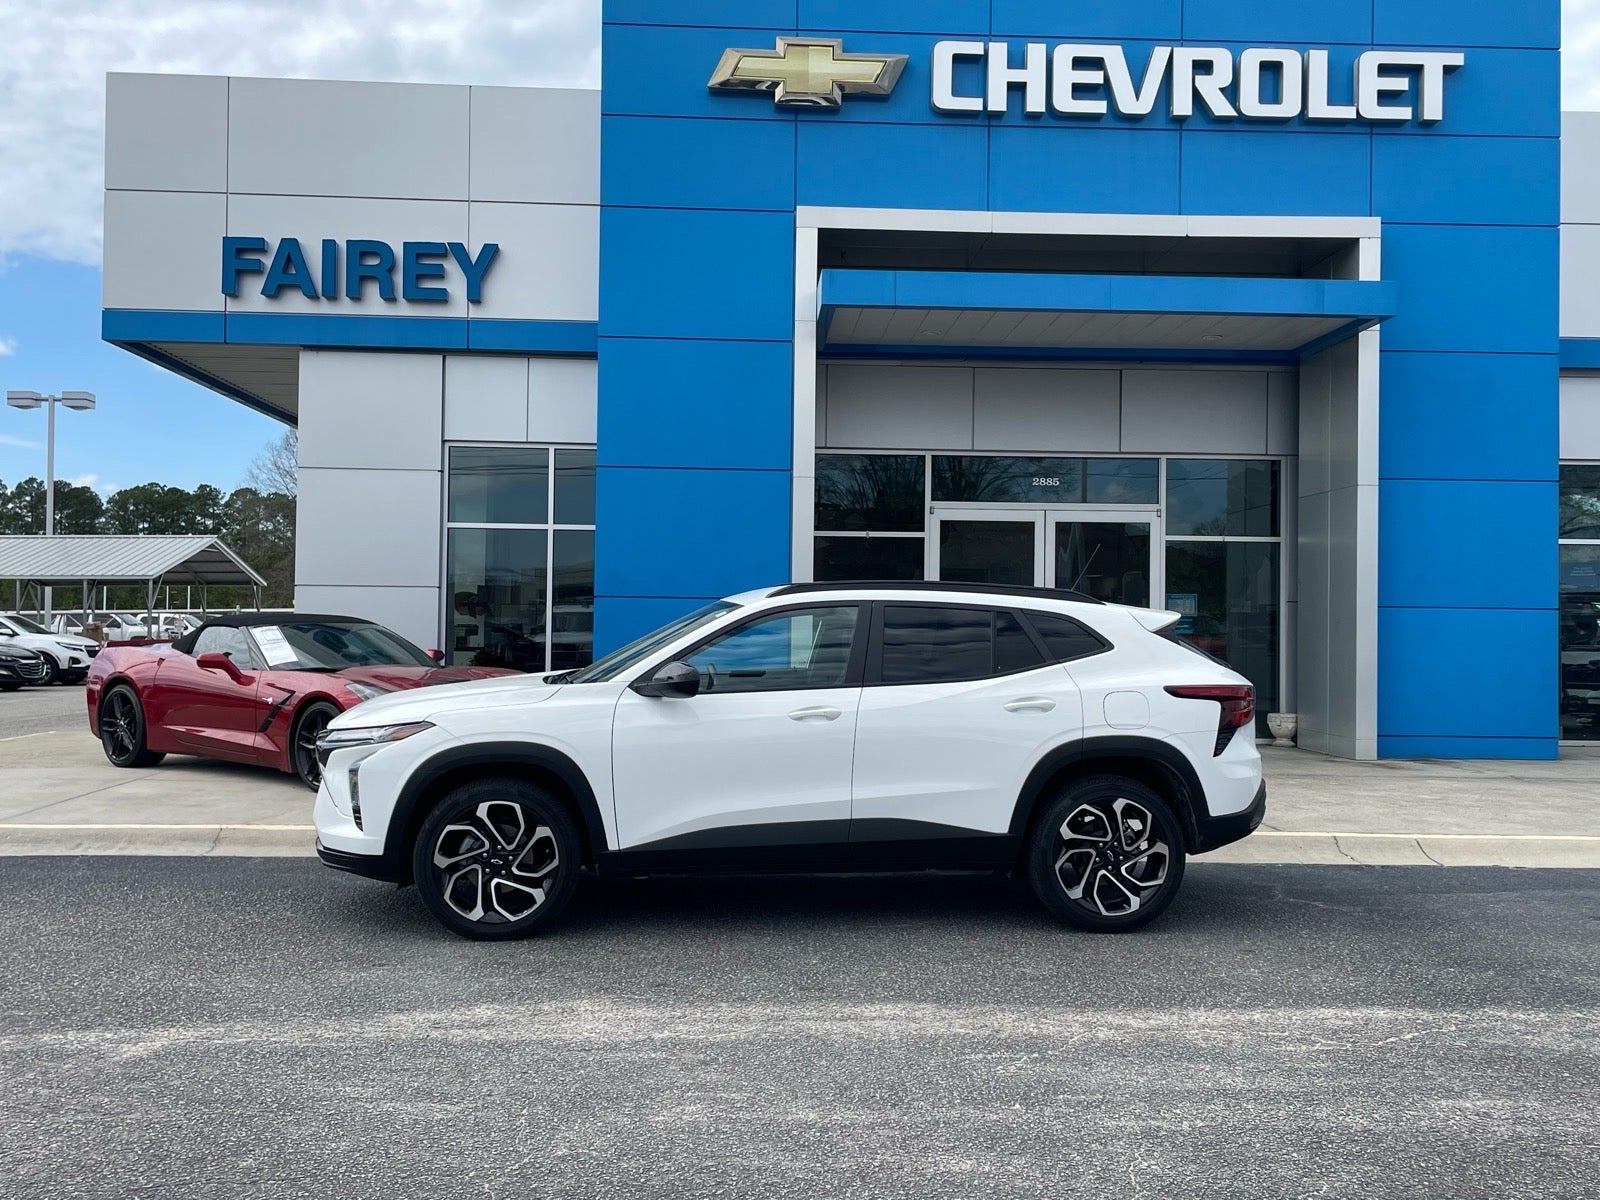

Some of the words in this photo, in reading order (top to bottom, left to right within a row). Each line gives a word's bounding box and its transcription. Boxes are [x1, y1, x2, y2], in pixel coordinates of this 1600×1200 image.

[932, 39, 1465, 123] CHEVROLET
[221, 235, 499, 304] FAIREY
[1032, 477, 1060, 486] 2885
